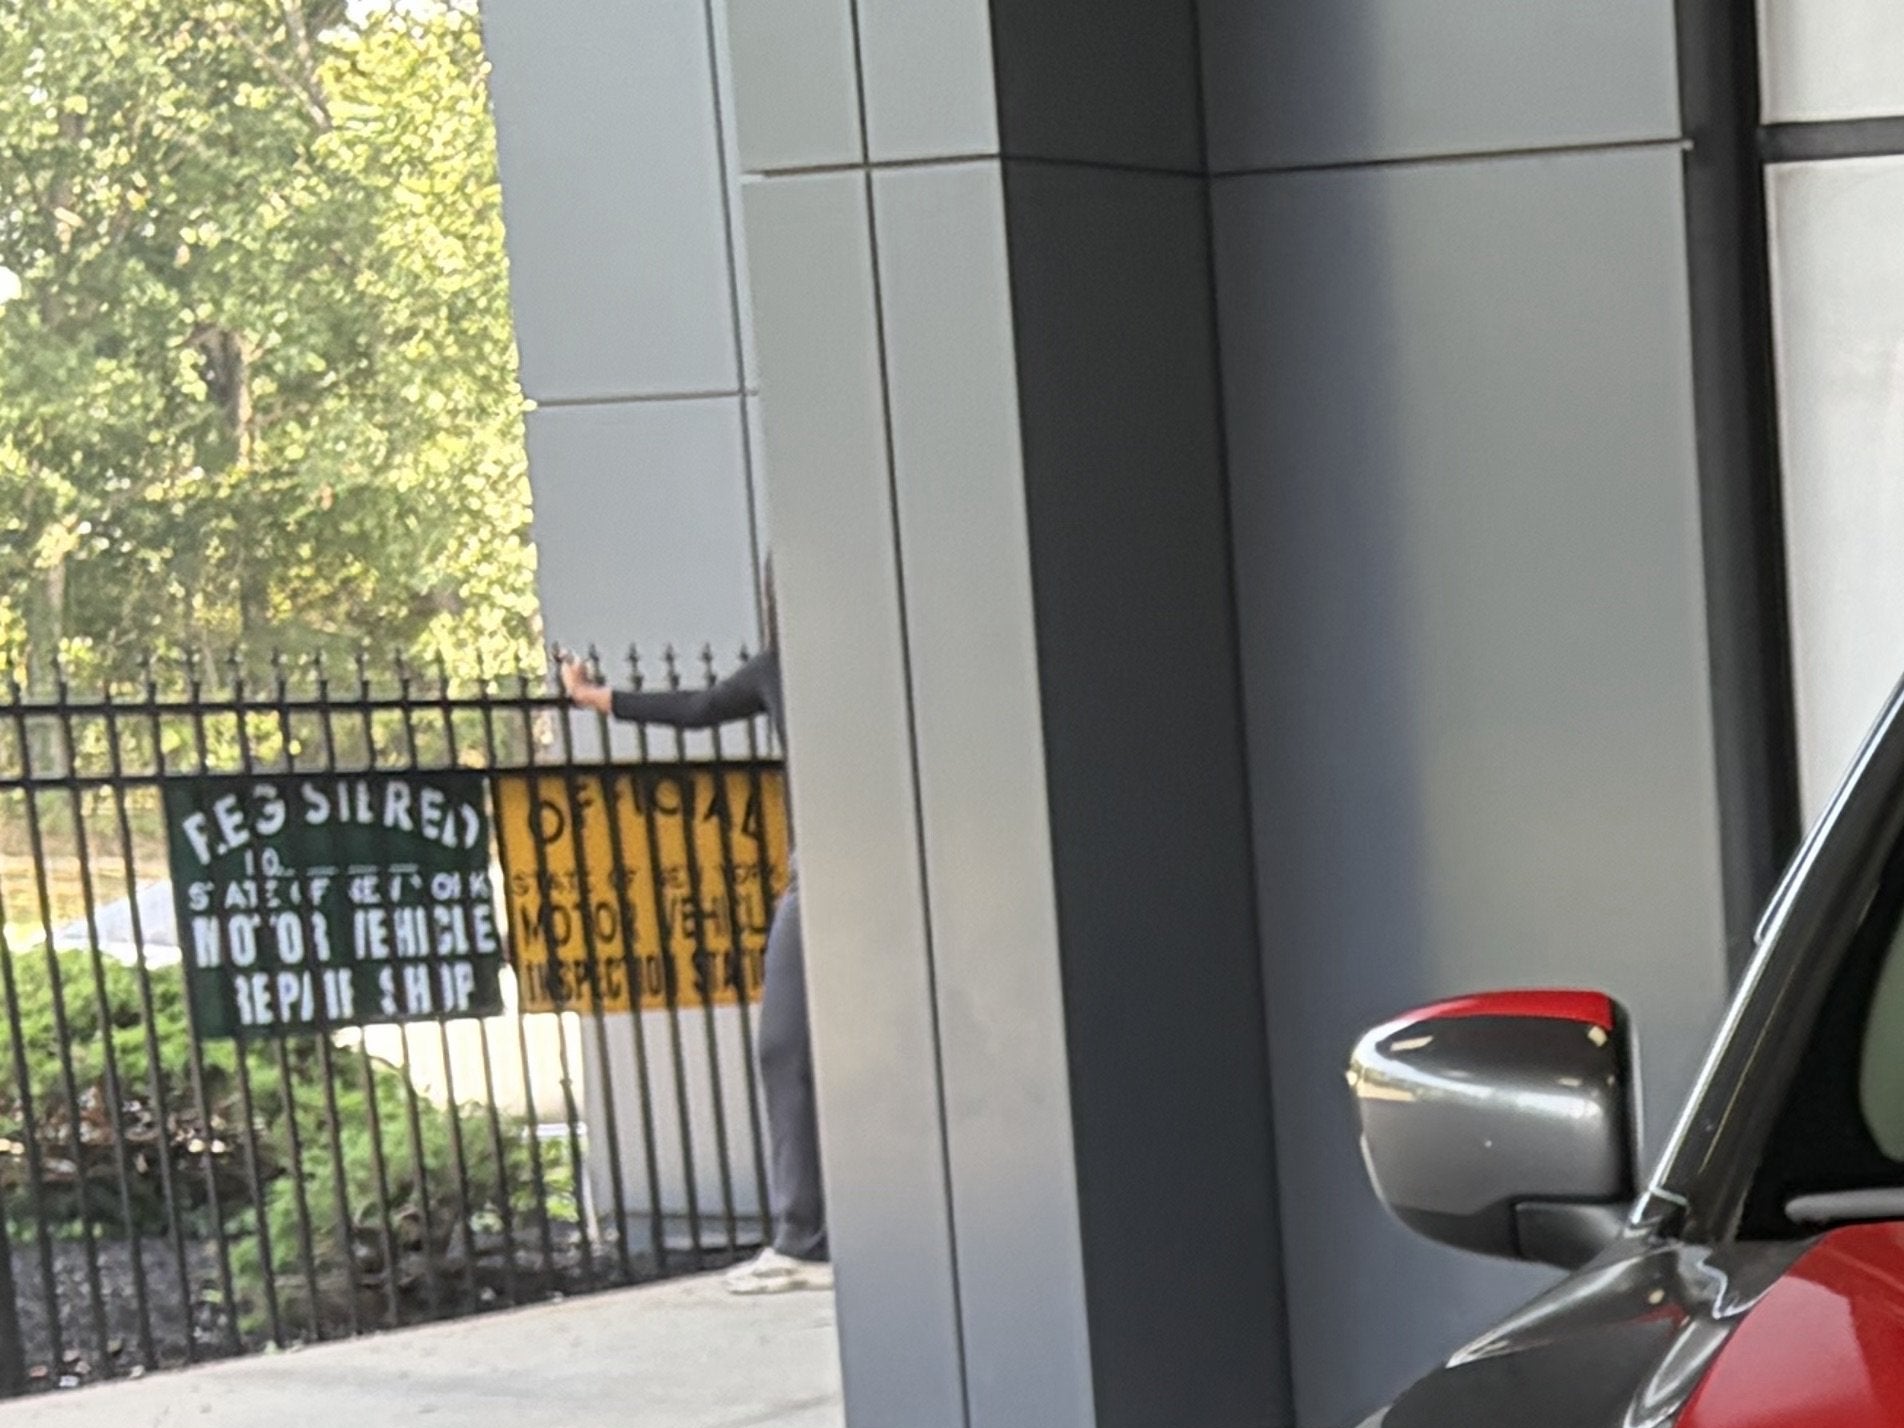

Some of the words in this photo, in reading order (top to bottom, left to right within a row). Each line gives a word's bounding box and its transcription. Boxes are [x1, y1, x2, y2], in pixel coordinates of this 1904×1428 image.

[182, 780, 480, 866] REGSTERED
[188, 878, 282, 911] SATE
[520, 900, 640, 947] MOO
